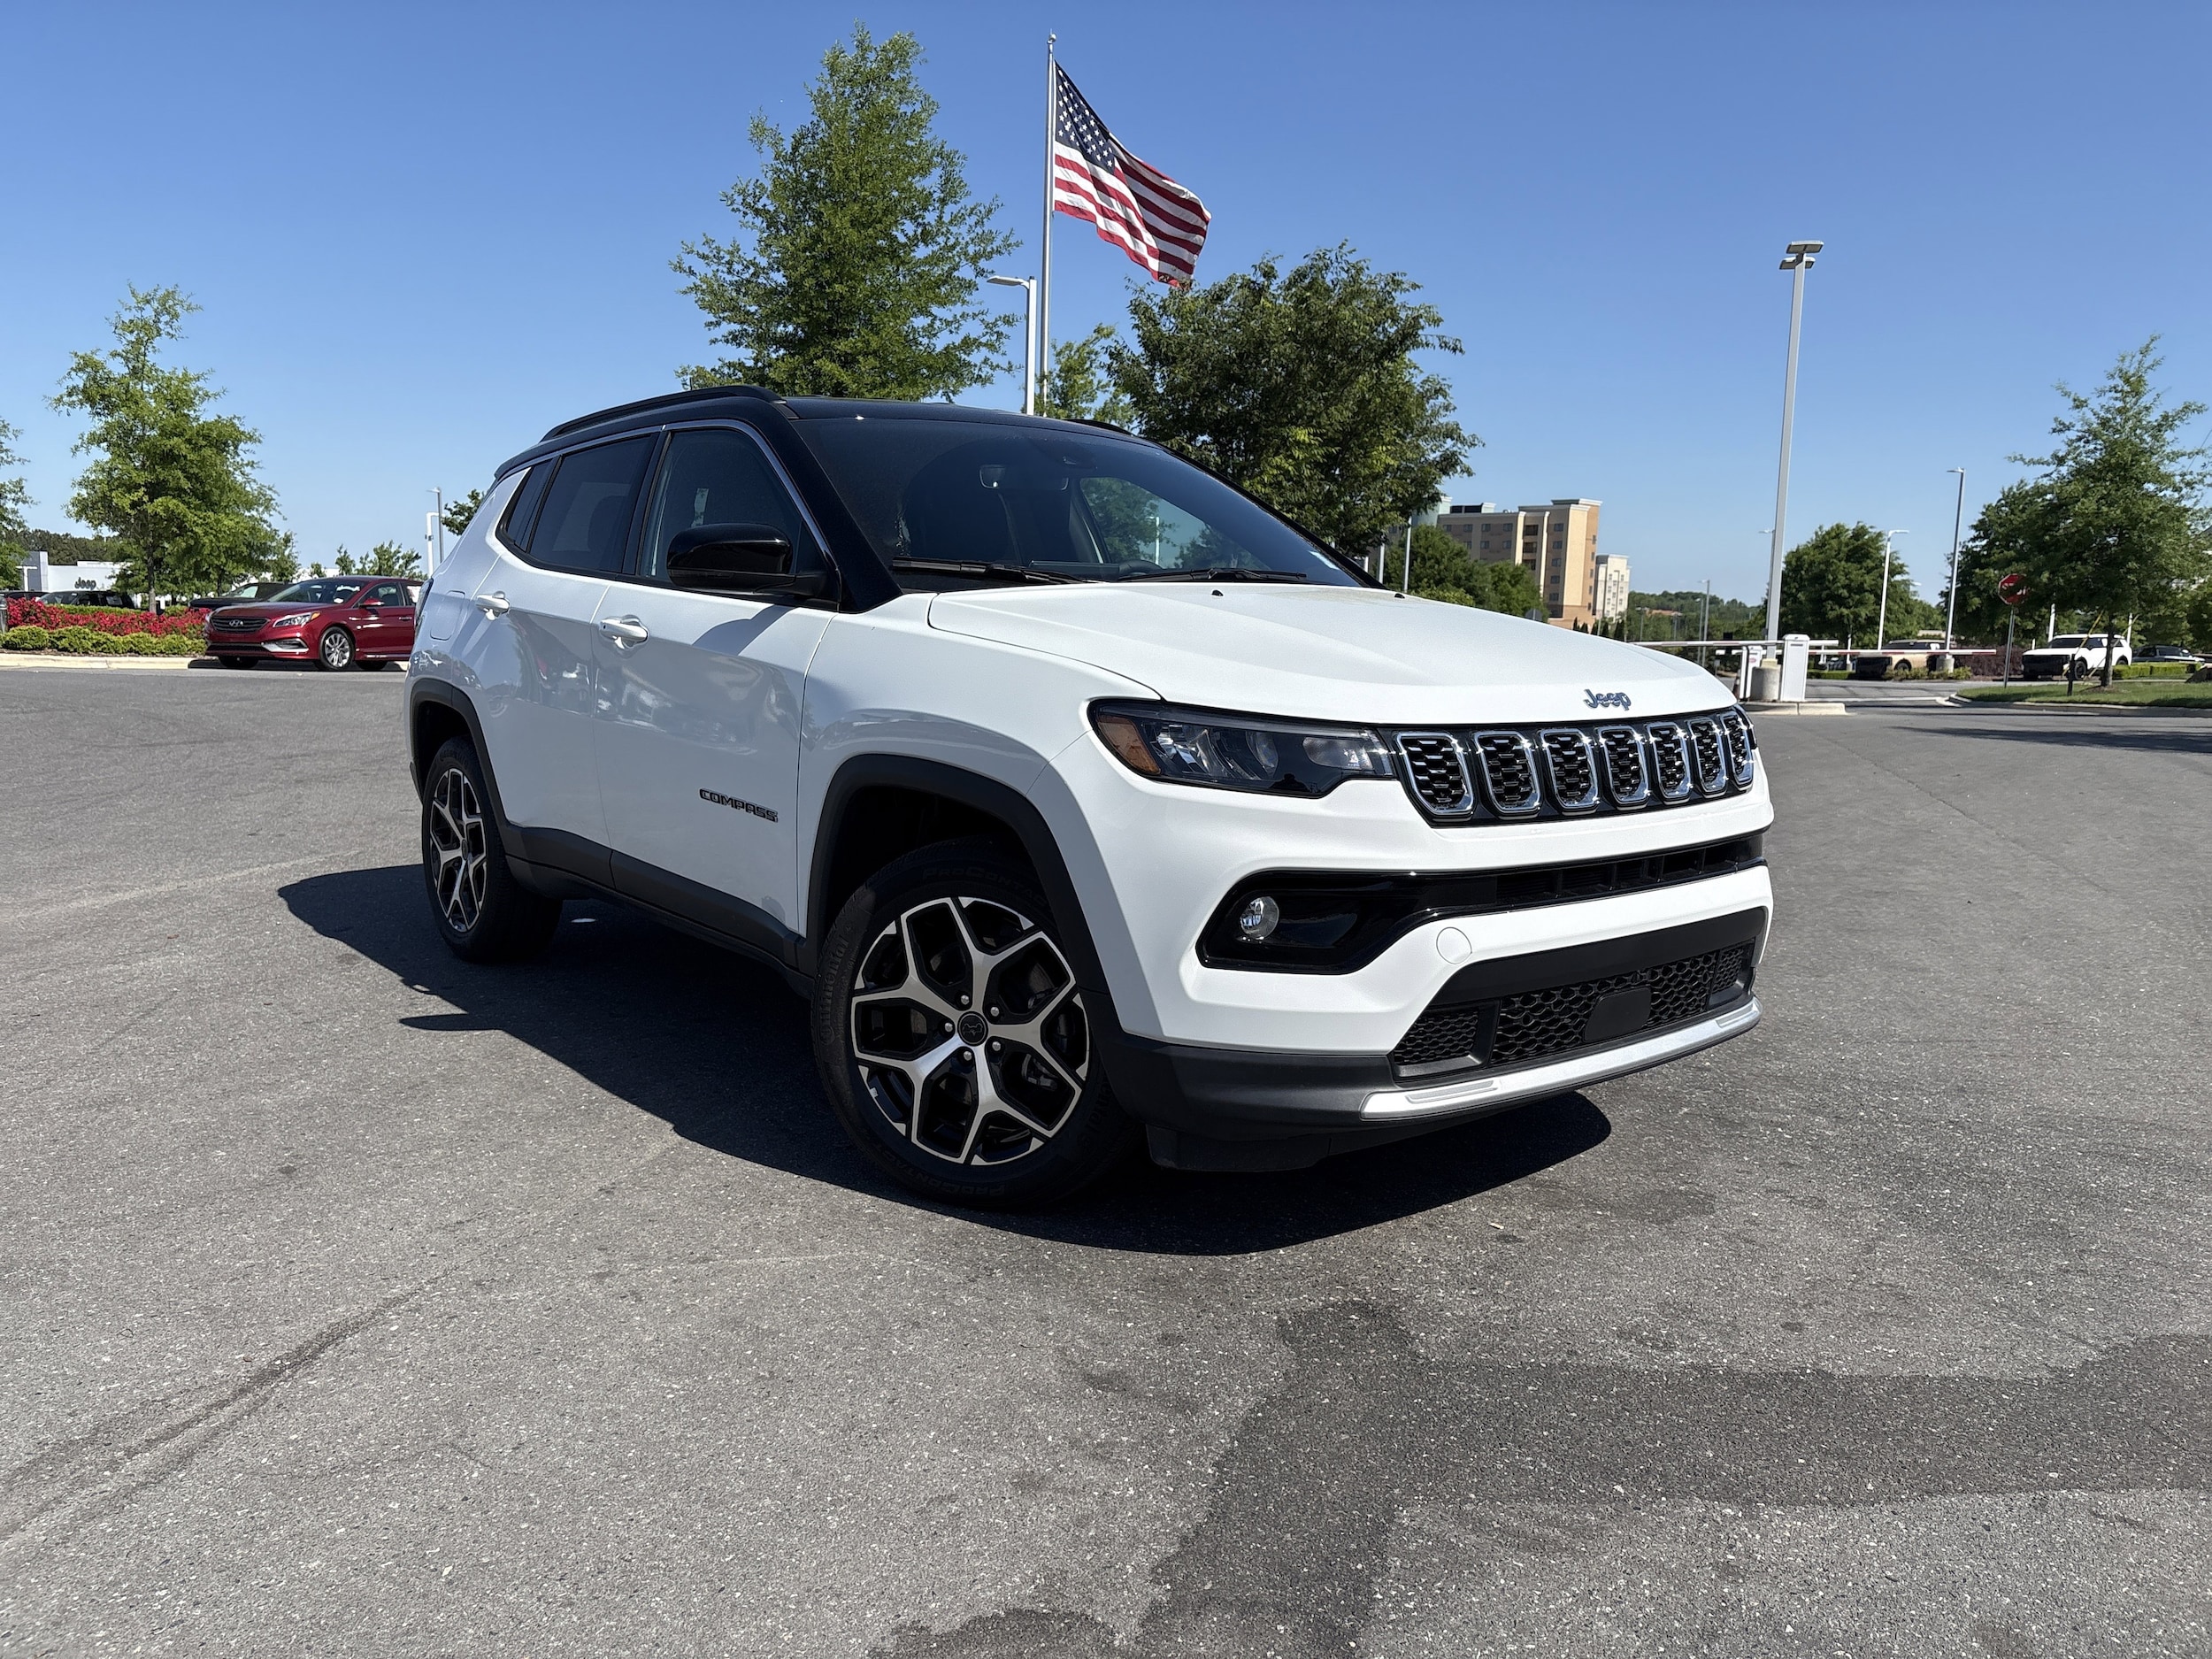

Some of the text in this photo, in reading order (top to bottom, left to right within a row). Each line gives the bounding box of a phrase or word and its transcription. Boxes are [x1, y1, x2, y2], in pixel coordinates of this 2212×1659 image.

[75, 577, 96, 591] Jeep
[1584, 689, 1631, 710] Jeep
[699, 788, 778, 822] COMPASS
